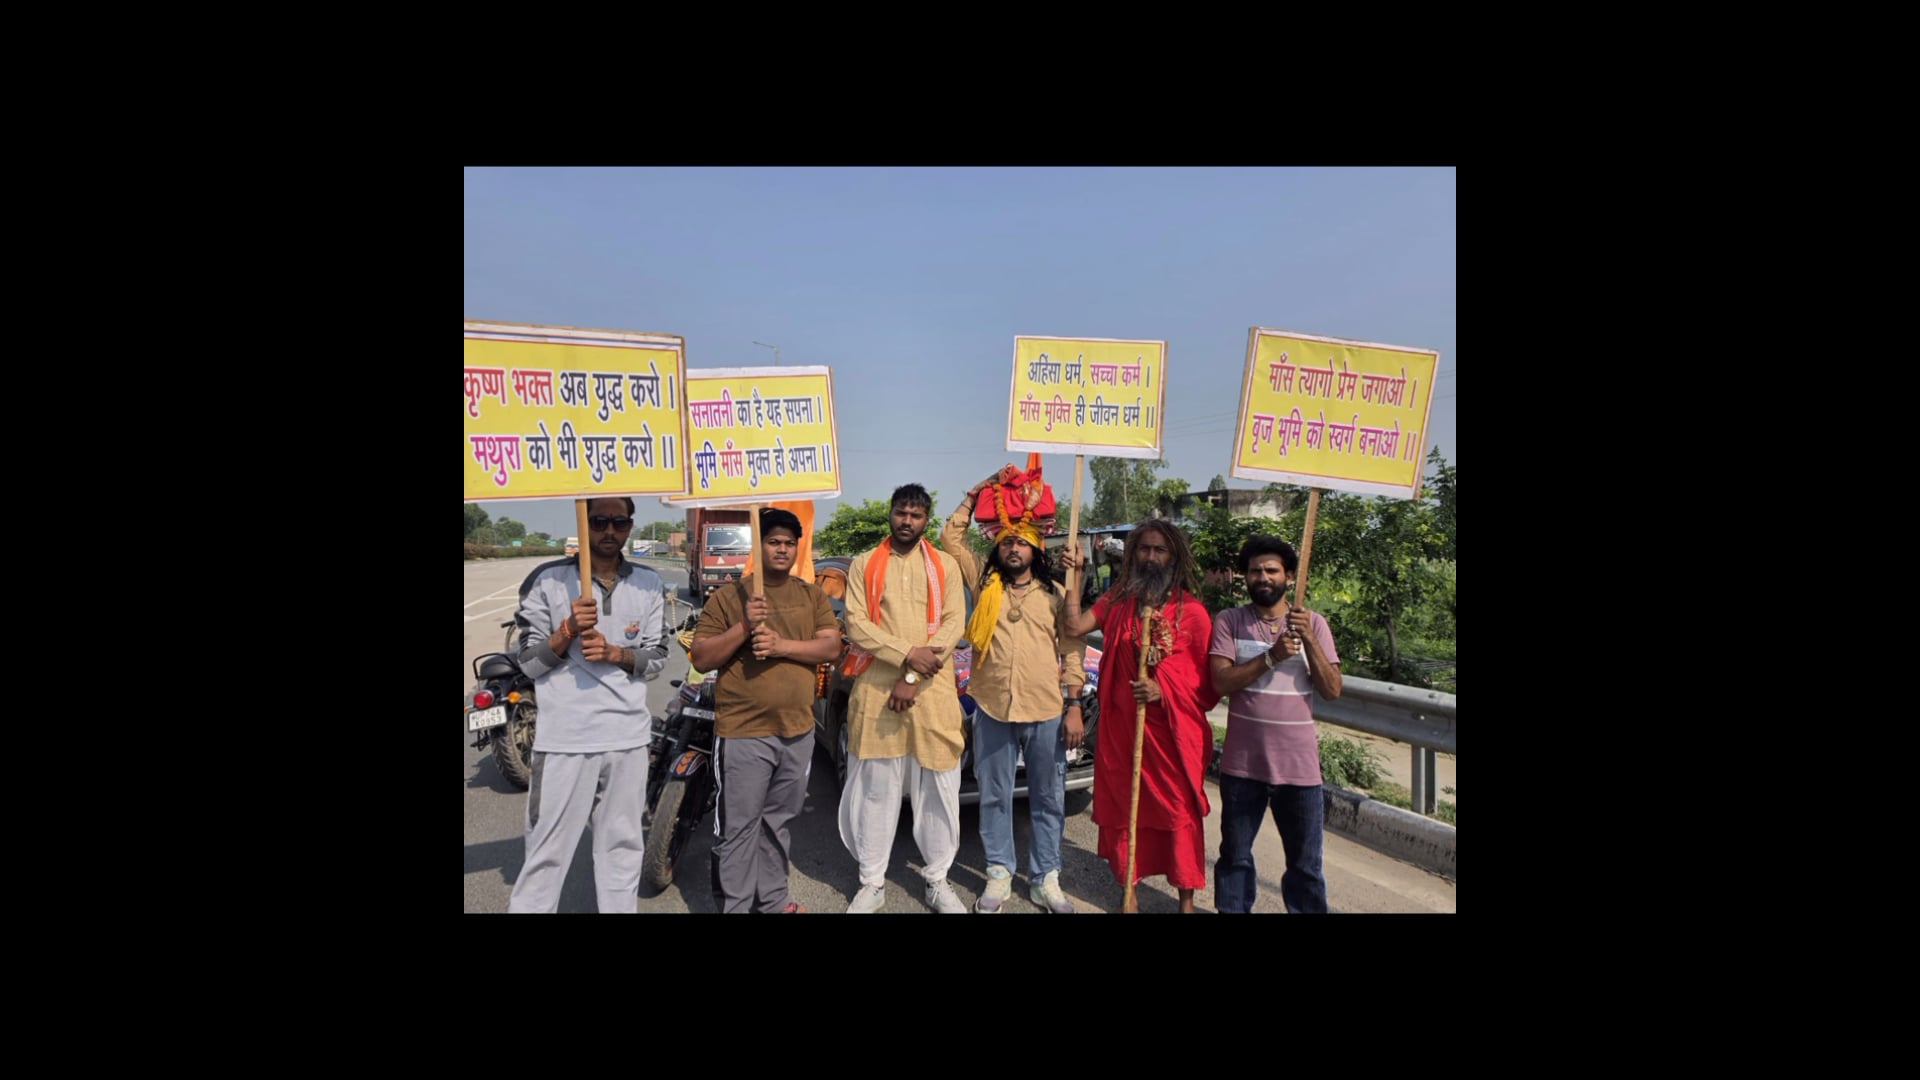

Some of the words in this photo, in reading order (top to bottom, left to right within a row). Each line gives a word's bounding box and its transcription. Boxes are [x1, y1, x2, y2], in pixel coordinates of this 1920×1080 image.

[512, 370, 553, 405] भक्त
[560, 372, 588, 406] अब
[593, 374, 623, 420] युद्ध
[629, 362, 660, 408] करो
[1028, 354, 1061, 385] अहिंसा
[1090, 364, 1118, 386] सच्चा
[1122, 357, 1142, 386] कर्म
[1300, 358, 1334, 398] त्यागो
[1336, 360, 1358, 400] प्रेम
[1362, 367, 1406, 406] जगाओ
[690, 389, 734, 428] सनातनी
[736, 400, 752, 426] का
[754, 388, 763, 428] है
[765, 400, 782, 427] यह
[784, 398, 814, 424] सपना
[1044, 394, 1072, 432] मुक्ति
[1075, 394, 1086, 427] ही
[1090, 395, 1119, 426] जीवन
[1123, 397, 1141, 428] धर्म
[471, 436, 520, 486] मथुरा
[526, 422, 551, 470] को
[558, 422, 578, 469] भी
[582, 437, 616, 483] शुद्ध
[622, 424, 653, 468] करो
[1279, 408, 1302, 456] भूमि
[1306, 411, 1324, 450] को
[1329, 413, 1358, 453] स्वर्ग
[1360, 420, 1400, 458] बनाओ
[695, 441, 717, 488] भूमि
[746, 450, 771, 488] मुक्त
[774, 438, 786, 476] हो
[788, 446, 818, 473] अपना
